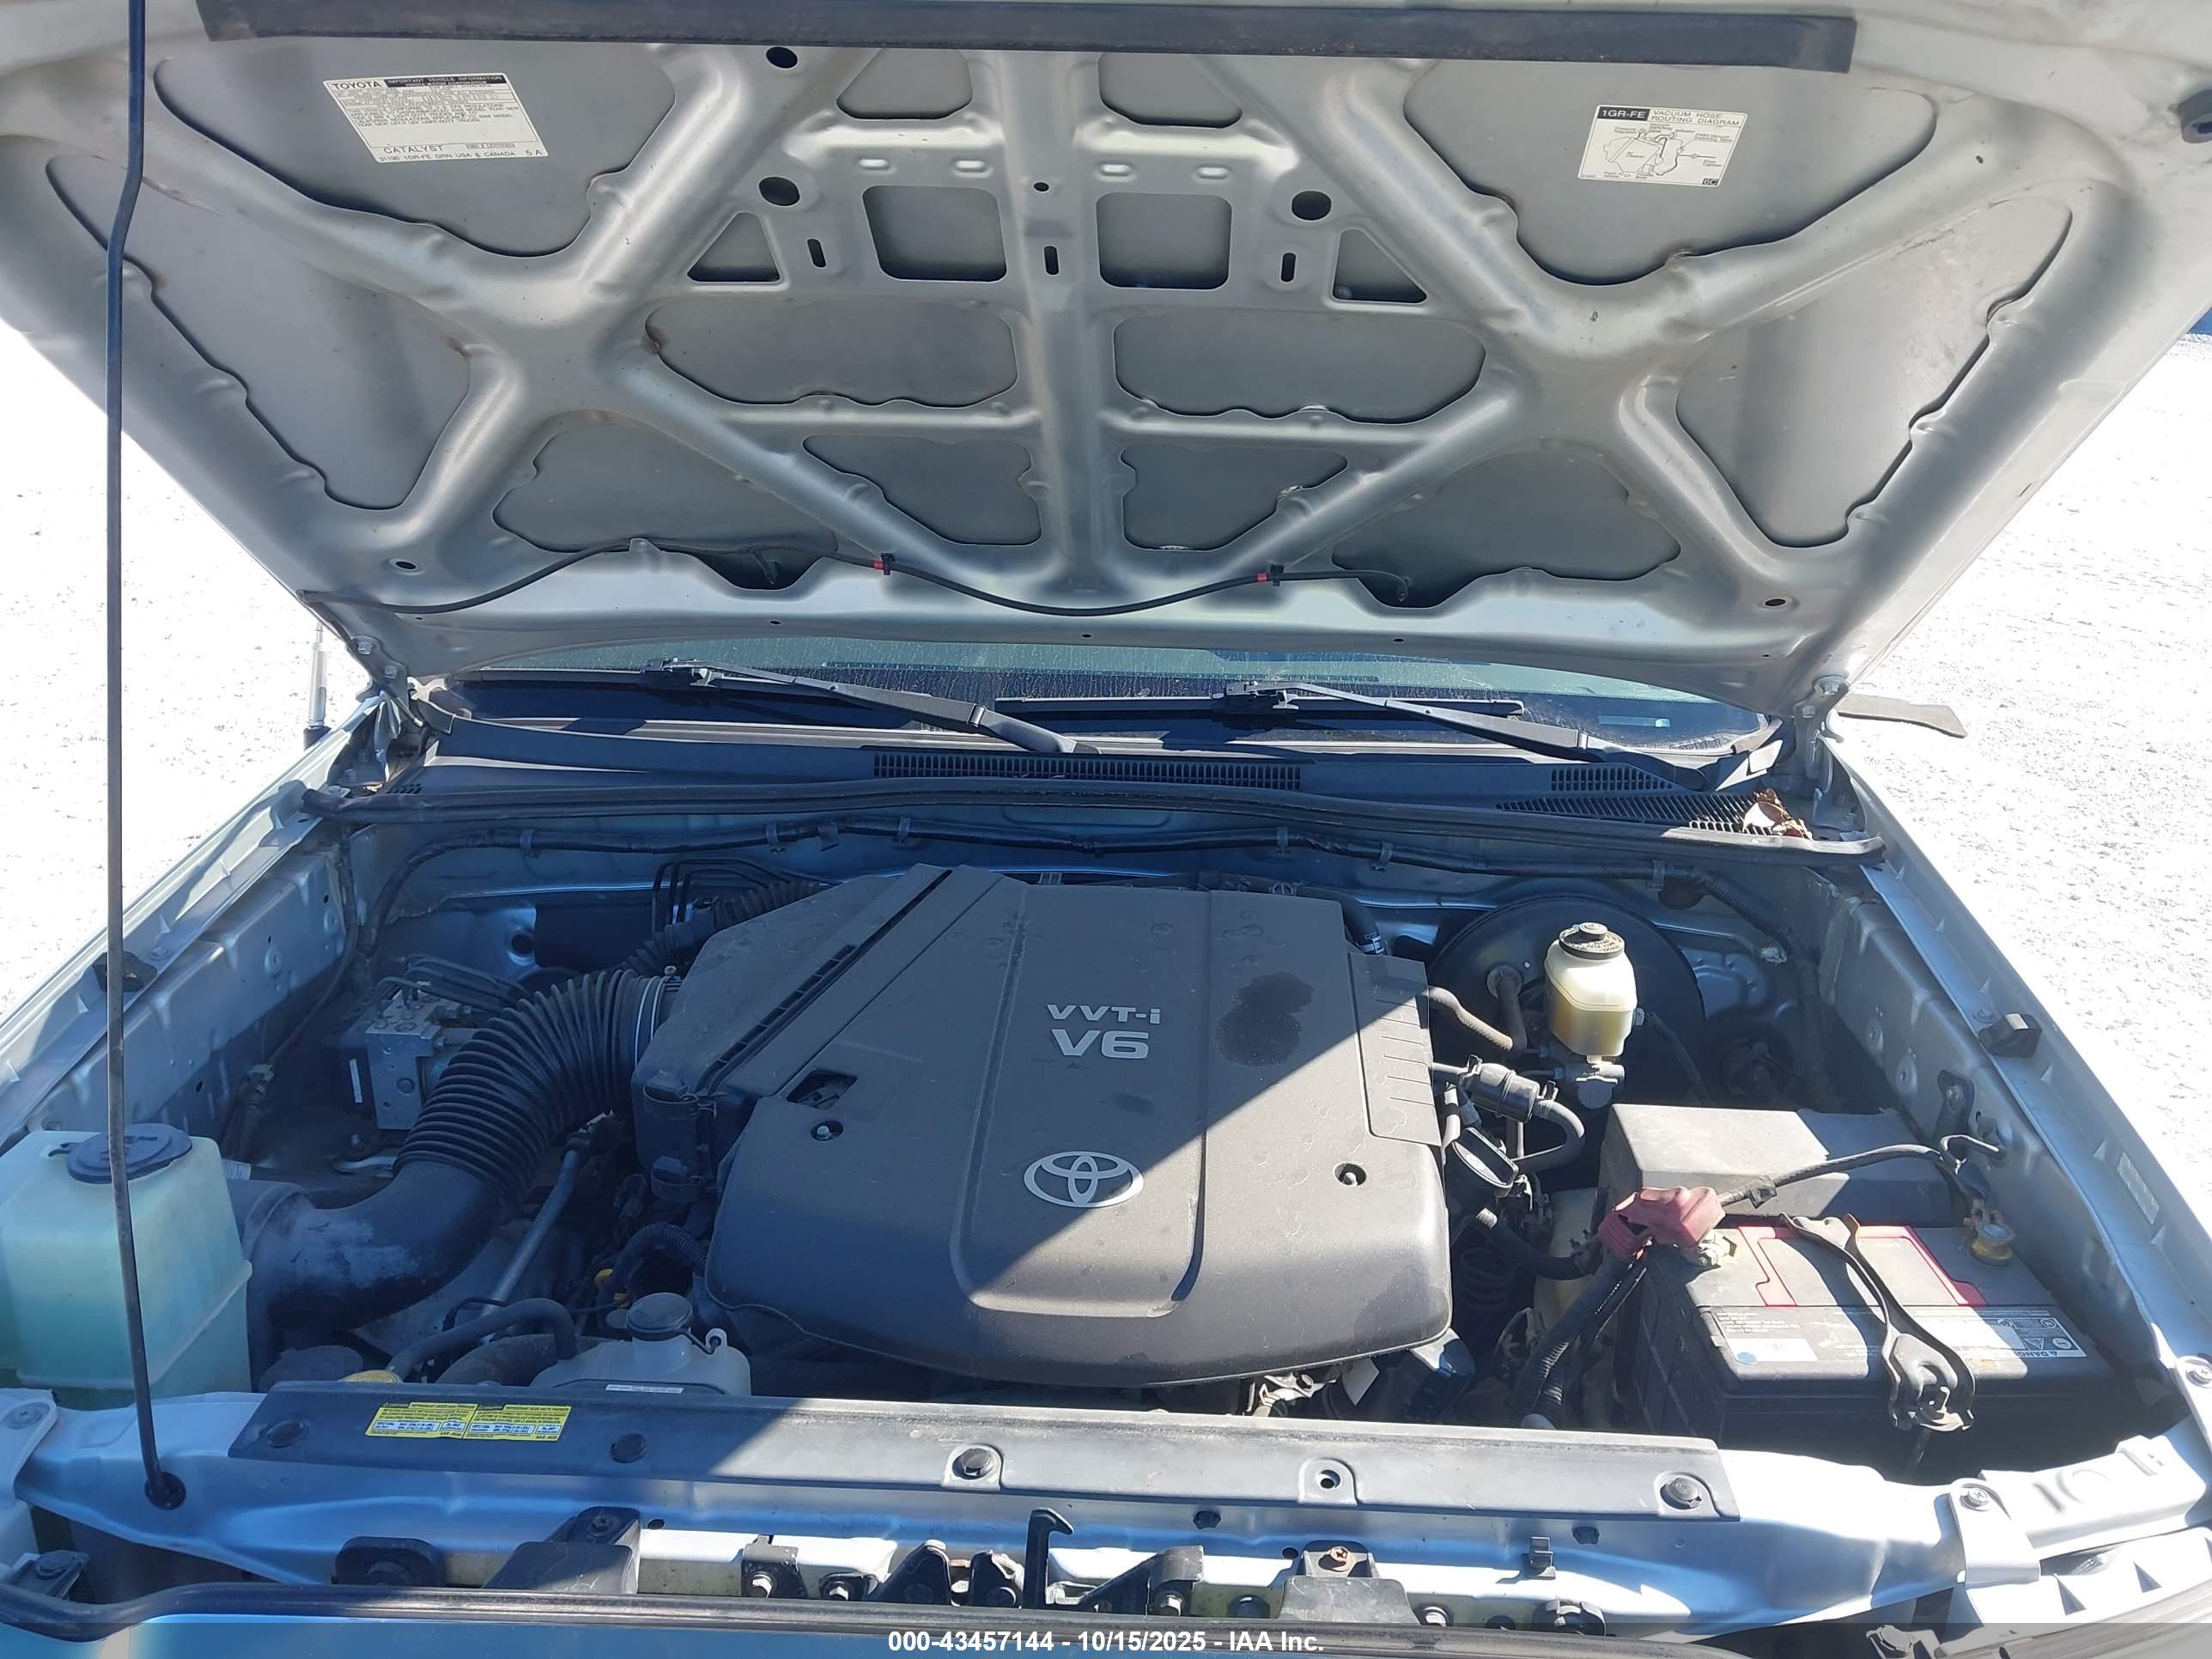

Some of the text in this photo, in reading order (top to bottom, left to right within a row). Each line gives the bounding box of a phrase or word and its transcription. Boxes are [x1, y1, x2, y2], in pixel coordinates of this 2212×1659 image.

[331, 81, 381, 90] TOYOTA
[1601, 110, 1647, 118] 1GR-FE
[1697, 118, 1740, 126] DIAGRAM
[383, 144, 444, 155] CATALYST
[1047, 1004, 1161, 1024] VVT-i
[1051, 1029, 1149, 1059] V6
